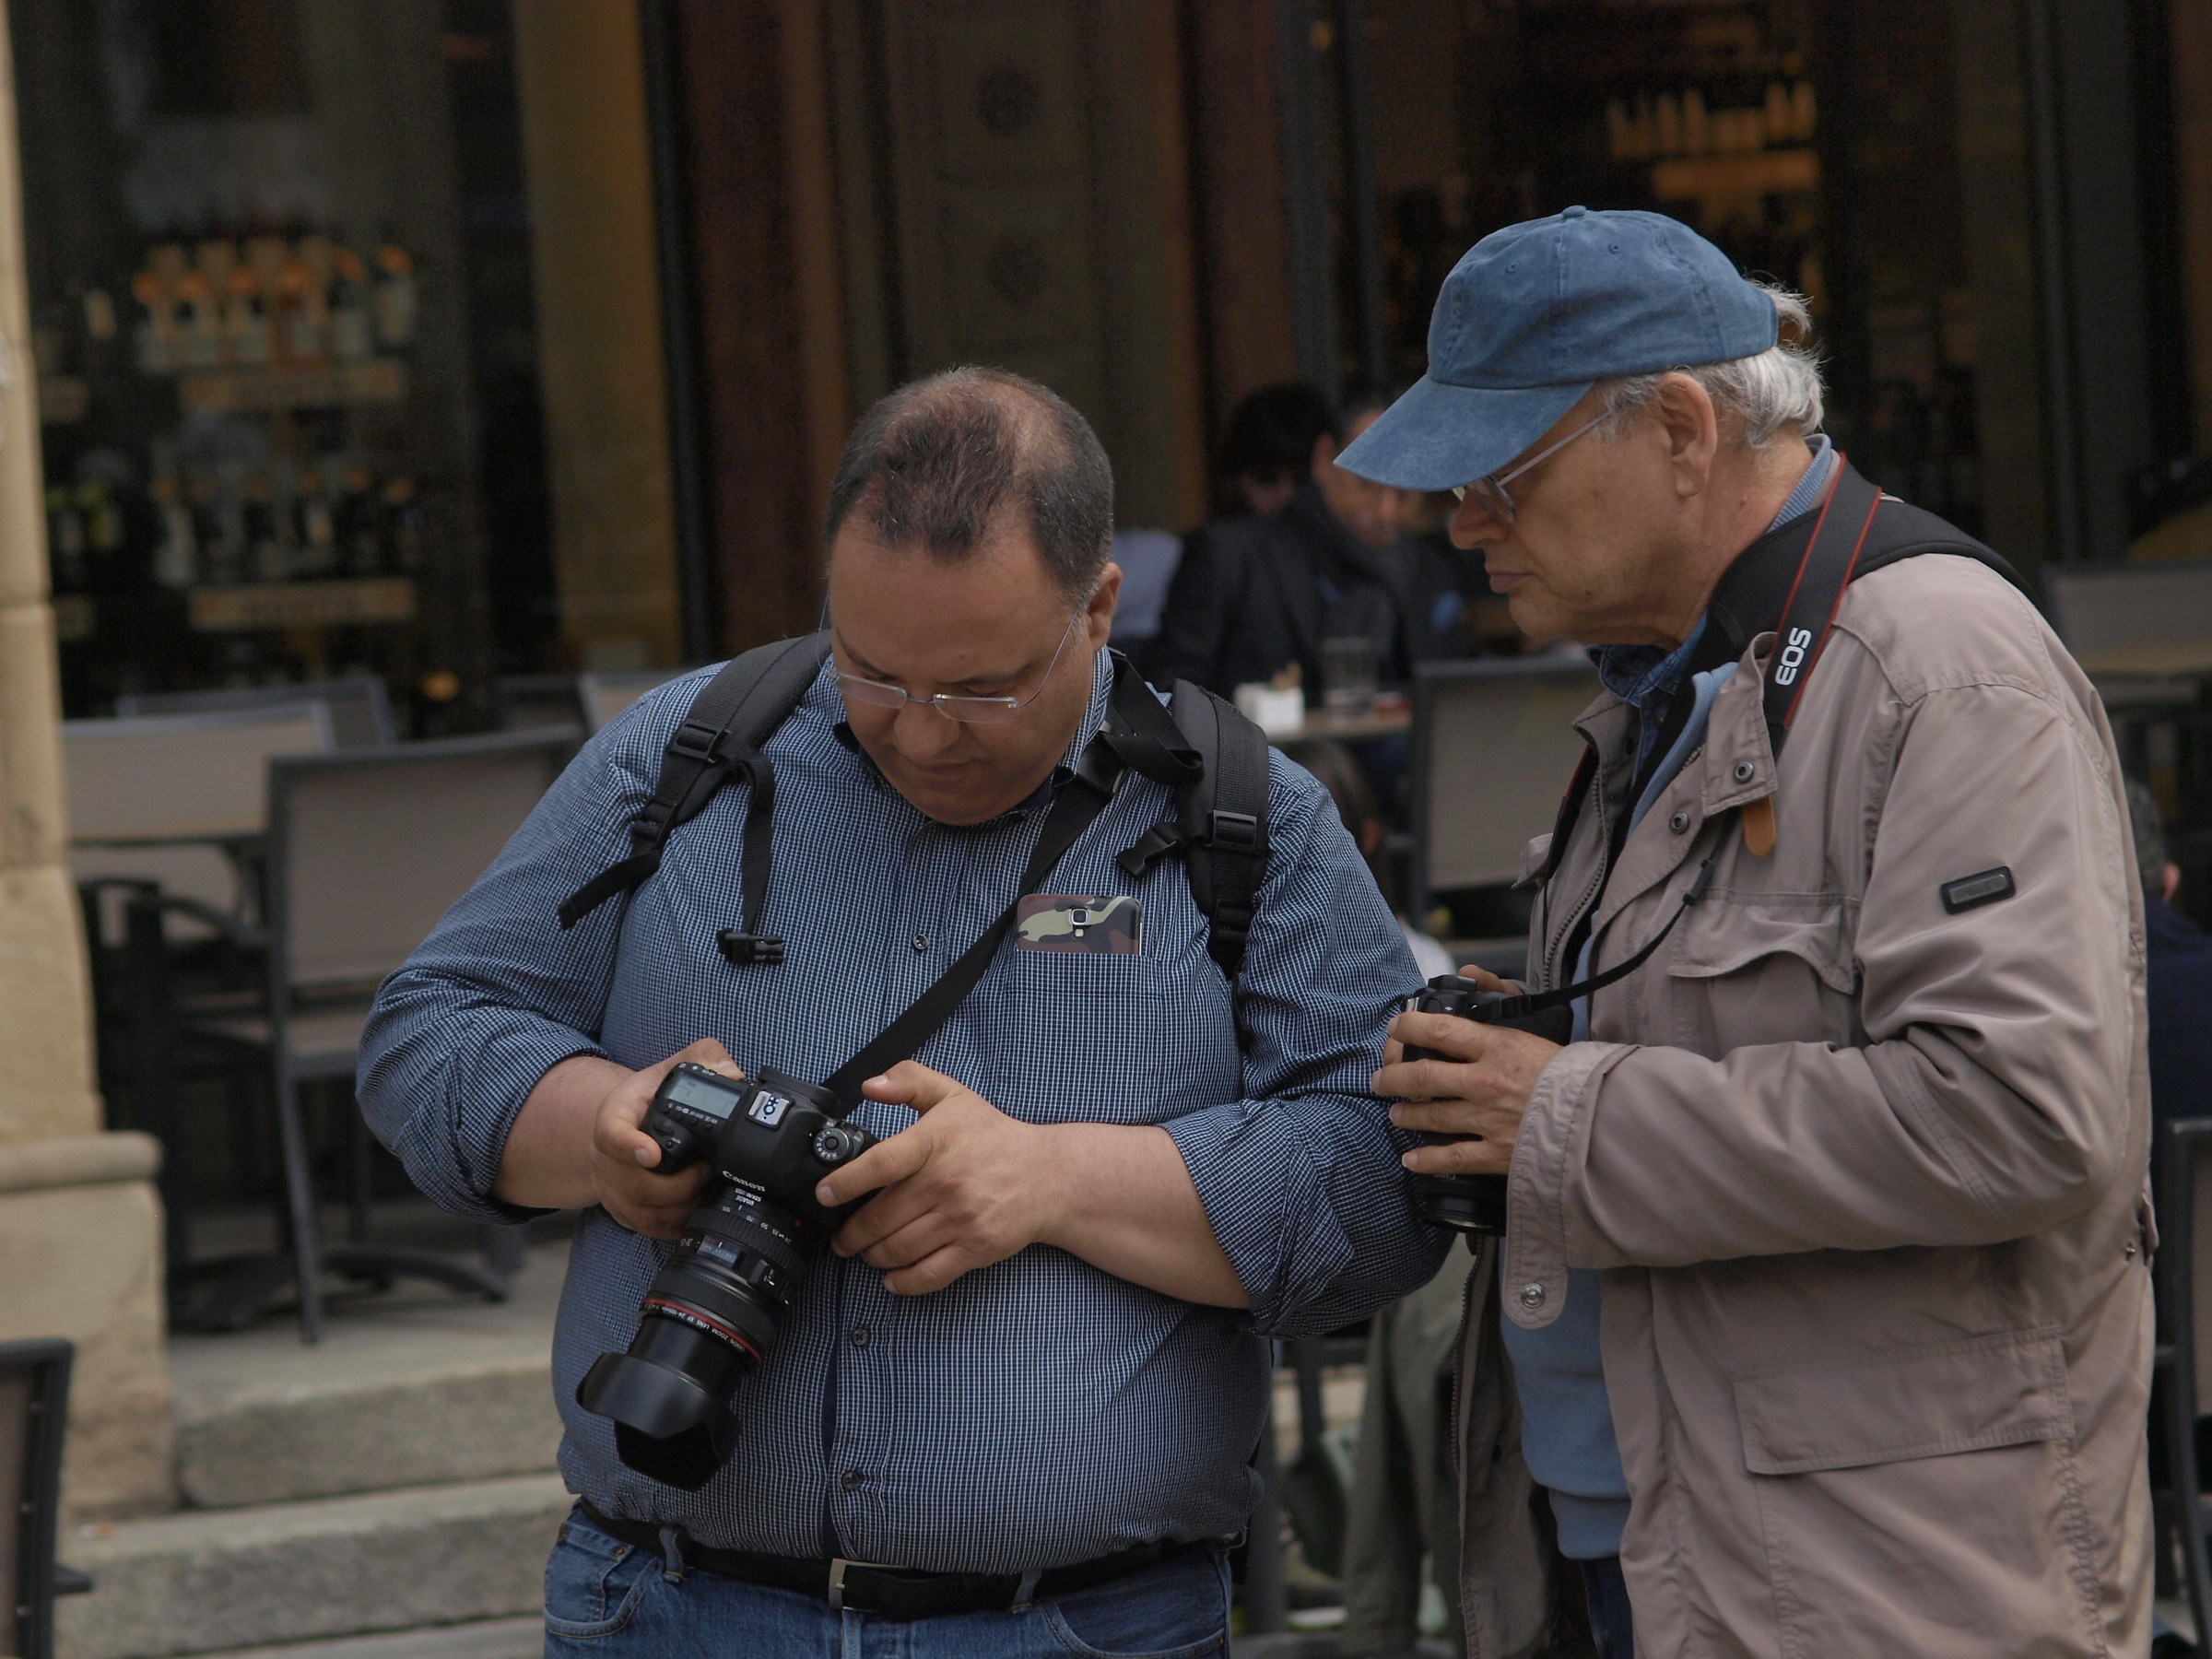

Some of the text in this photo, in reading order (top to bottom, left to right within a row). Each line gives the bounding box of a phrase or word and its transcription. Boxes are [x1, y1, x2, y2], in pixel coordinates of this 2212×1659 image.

[1774, 627, 1812, 686] EOS
[722, 1170, 766, 1192] Canon
[712, 1327, 729, 1341] ZOOM
